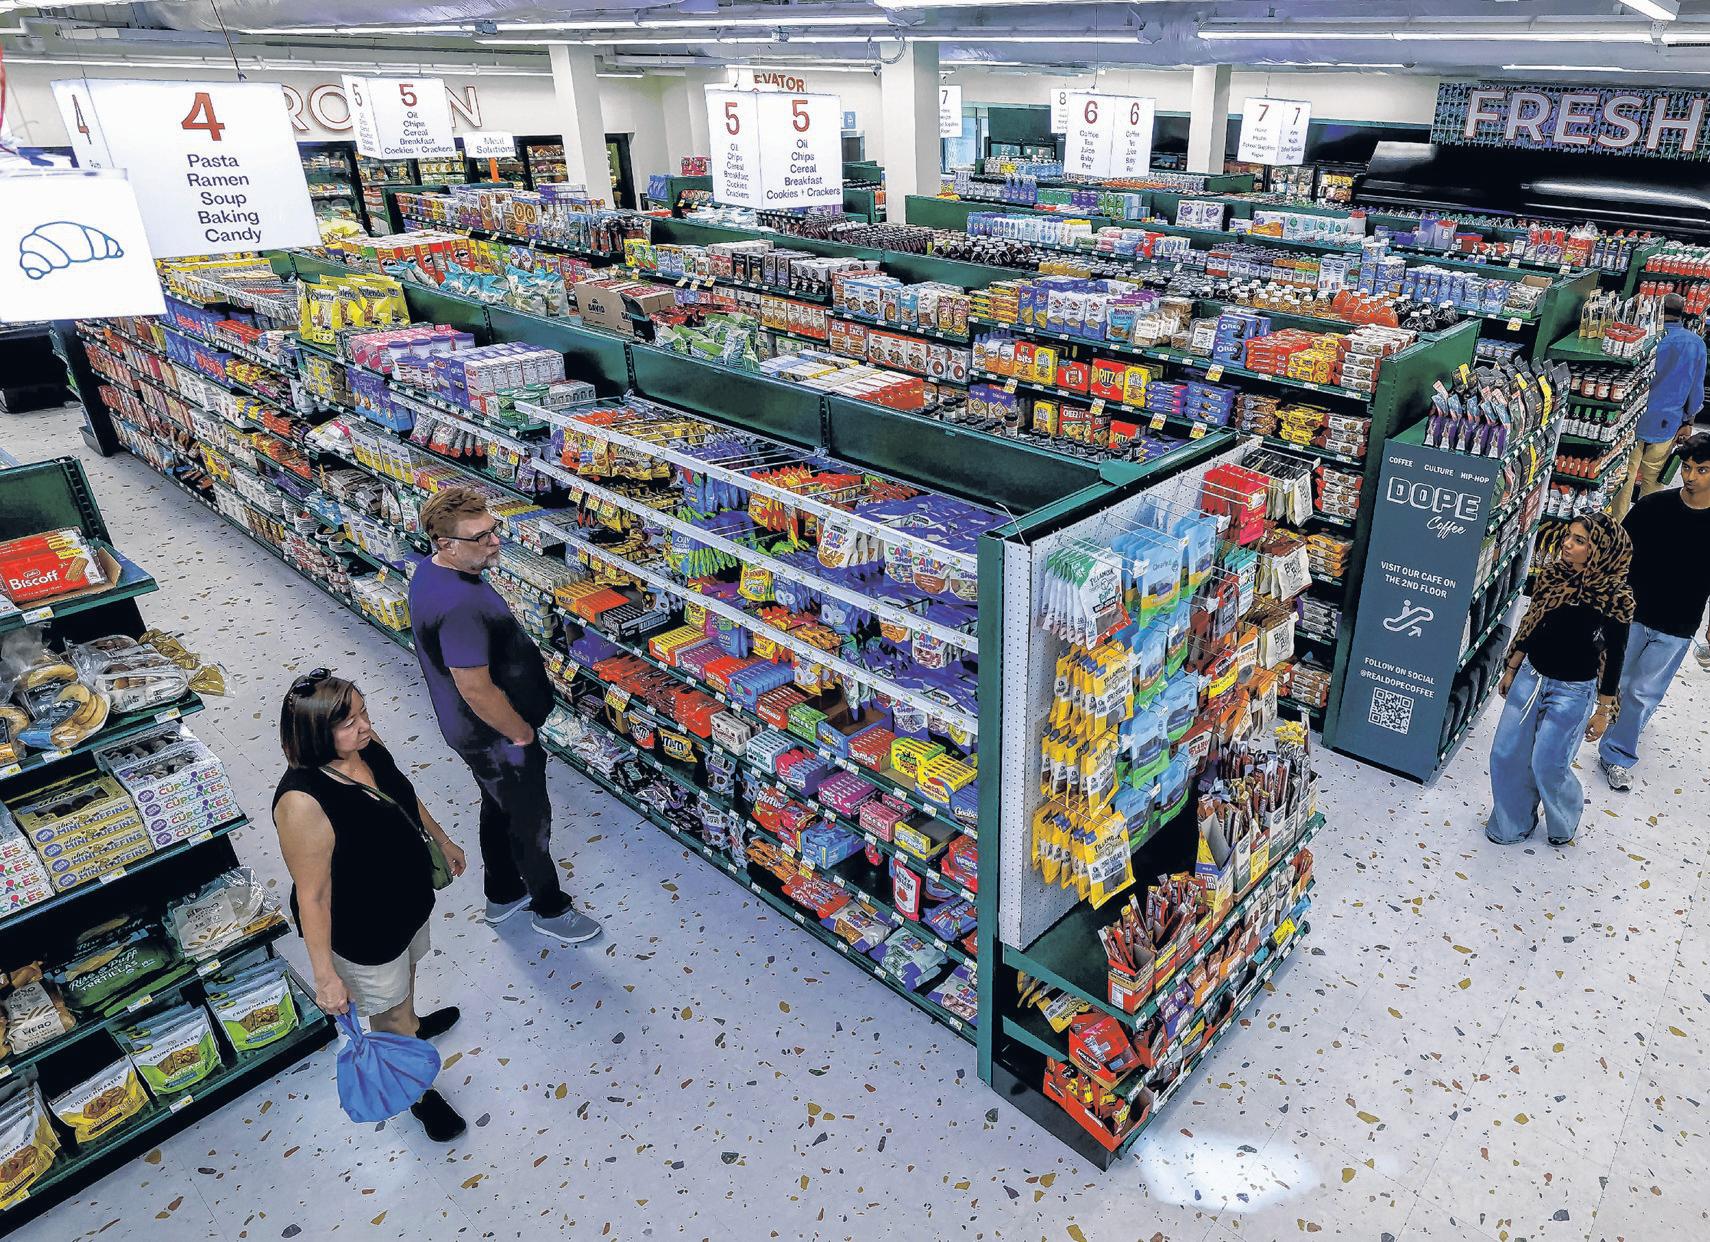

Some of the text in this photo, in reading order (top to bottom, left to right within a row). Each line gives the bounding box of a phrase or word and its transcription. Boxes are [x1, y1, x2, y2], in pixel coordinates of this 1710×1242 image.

[754, 73, 805, 92] EVATOR
[352, 83, 363, 107] 5
[399, 83, 418, 107] 5
[941, 90, 949, 104] 7
[1059, 92, 1067, 105] 8
[72, 94, 91, 145] 4
[181, 92, 225, 141] 4
[406, 111, 419, 119] Oil
[724, 101, 740, 135] 5
[792, 99, 810, 132] 5
[1084, 100, 1098, 124] 6
[1130, 102, 1140, 125] 6
[1258, 104, 1269, 121] 7
[1294, 107, 1301, 125] 7
[1464, 89, 1703, 150] FRESH
[403, 120, 426, 128] Chips
[400, 138, 435, 146] Breakfast
[796, 139, 808, 149] Oil
[187, 154, 239, 169] Pasta
[726, 161, 745, 171] Cereal
[727, 152, 743, 162] Chips
[791, 152, 815, 162] Chips
[724, 170, 750, 181] Breakfast
[790, 164, 817, 174] Cereal
[187, 172, 249, 187] Ramen
[726, 180, 748, 190] Cookies
[784, 176, 823, 186] Breakfast
[200, 191, 247, 207] Soup
[726, 189, 750, 199] Crackers
[767, 189, 799, 199] Cookies
[806, 187, 840, 197] Crackers
[198, 209, 260, 226] Baking
[205, 228, 262, 244] Candy
[1100, 368, 1116, 383] RITZ
[1389, 456, 1490, 484] COFFEE CULTURE HIP-HOP
[1387, 477, 1481, 521] DOPE
[1426, 516, 1466, 539] Coffee
[823, 529, 849, 545] CANDY
[912, 556, 944, 571] CANDY
[920, 567, 939, 575] SHOP
[9, 570, 58, 590] Biscoff
[1380, 561, 1456, 588] VISIT OUR CAFE ON
[1385, 574, 1448, 598] THE 2ND FLOOR
[912, 630, 944, 647] CANDY
[919, 642, 937, 651] SHOP
[1364, 657, 1435, 684] FOLLOW ON SOCIAL
[1360, 669, 1435, 698] @REALDOPECOFFEE
[159, 769, 219, 795] CUPCAKES
[166, 783, 224, 809] CUPCAKES
[57, 804, 129, 834] MINI MUFFINS
[171, 796, 229, 824] CUPCAKES
[65, 818, 136, 849] MINI MUFFINS
[176, 811, 234, 838] CUPCAKES
[72, 832, 143, 865] MINI MUFFINS
[80, 846, 148, 880] MINI MUFFINS
[22, 1021, 52, 1036] HERO
[149, 1034, 199, 1062] CRUNCHMASTER
[70, 1075, 122, 1108] CRUNCHMASTER
[0, 1133, 32, 1161] CHMASTER
